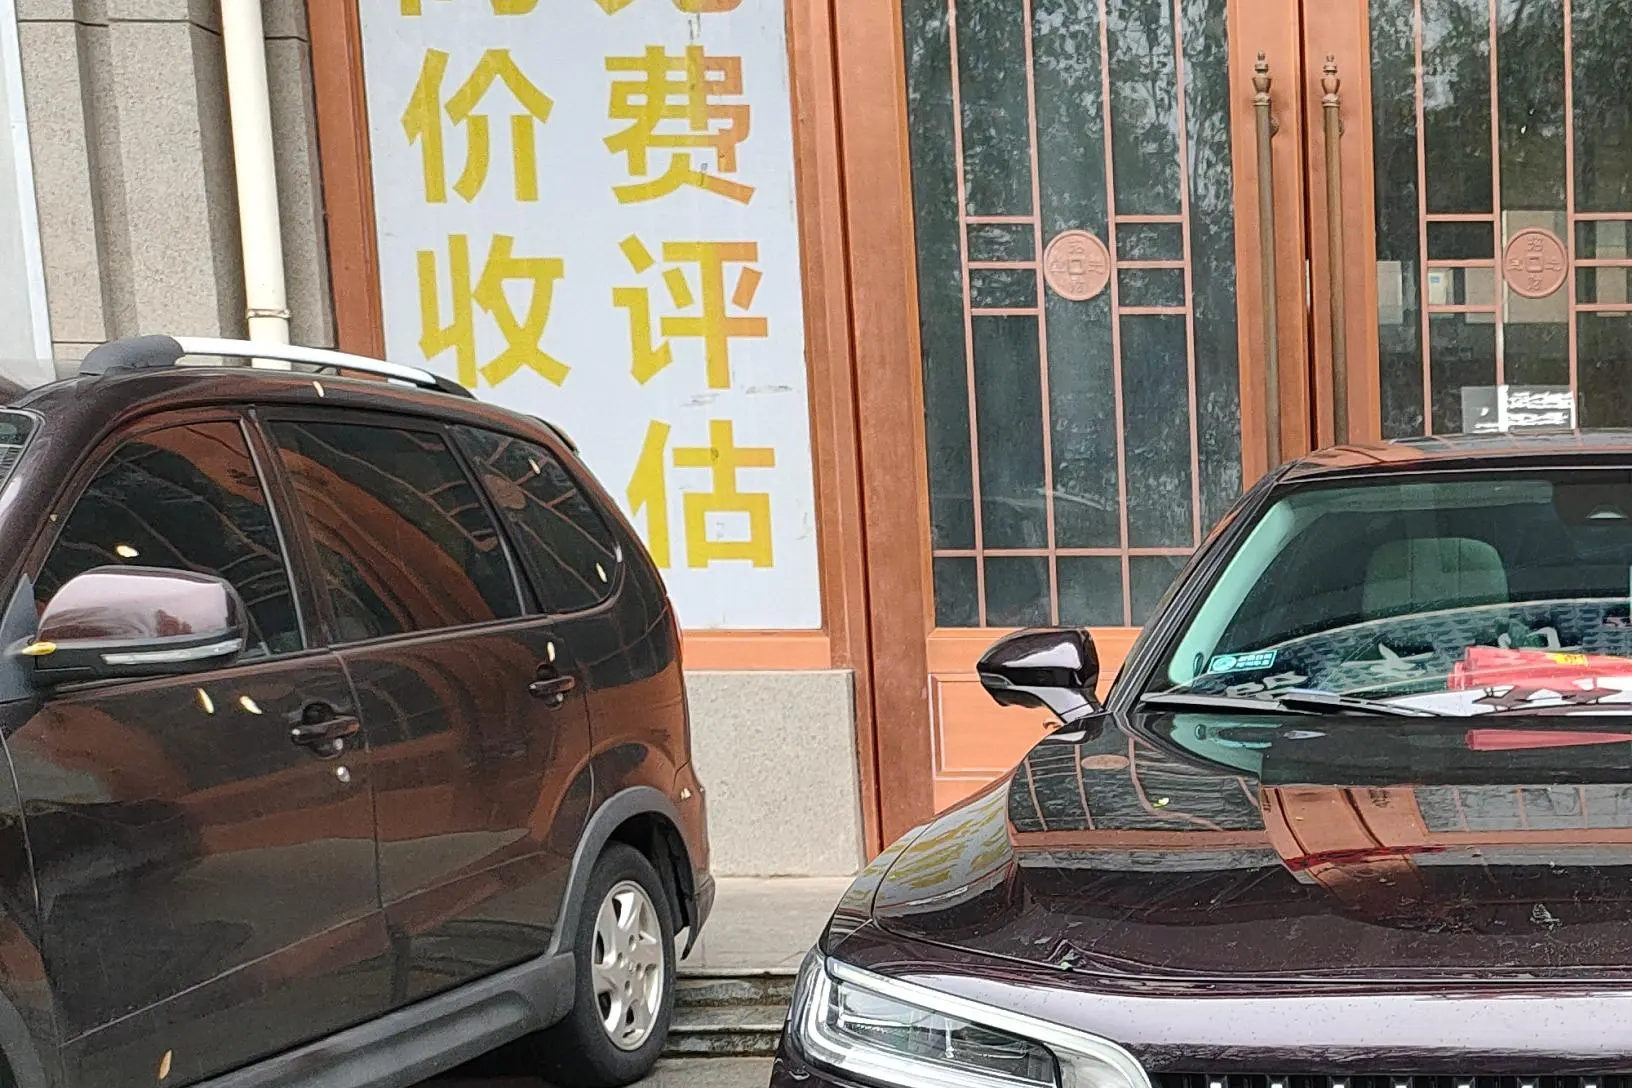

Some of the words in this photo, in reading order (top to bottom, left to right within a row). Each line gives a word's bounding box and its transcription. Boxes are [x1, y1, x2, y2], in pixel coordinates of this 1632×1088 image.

[400, 0, 572, 389] 价收
[590, 0, 776, 570] 费评估
